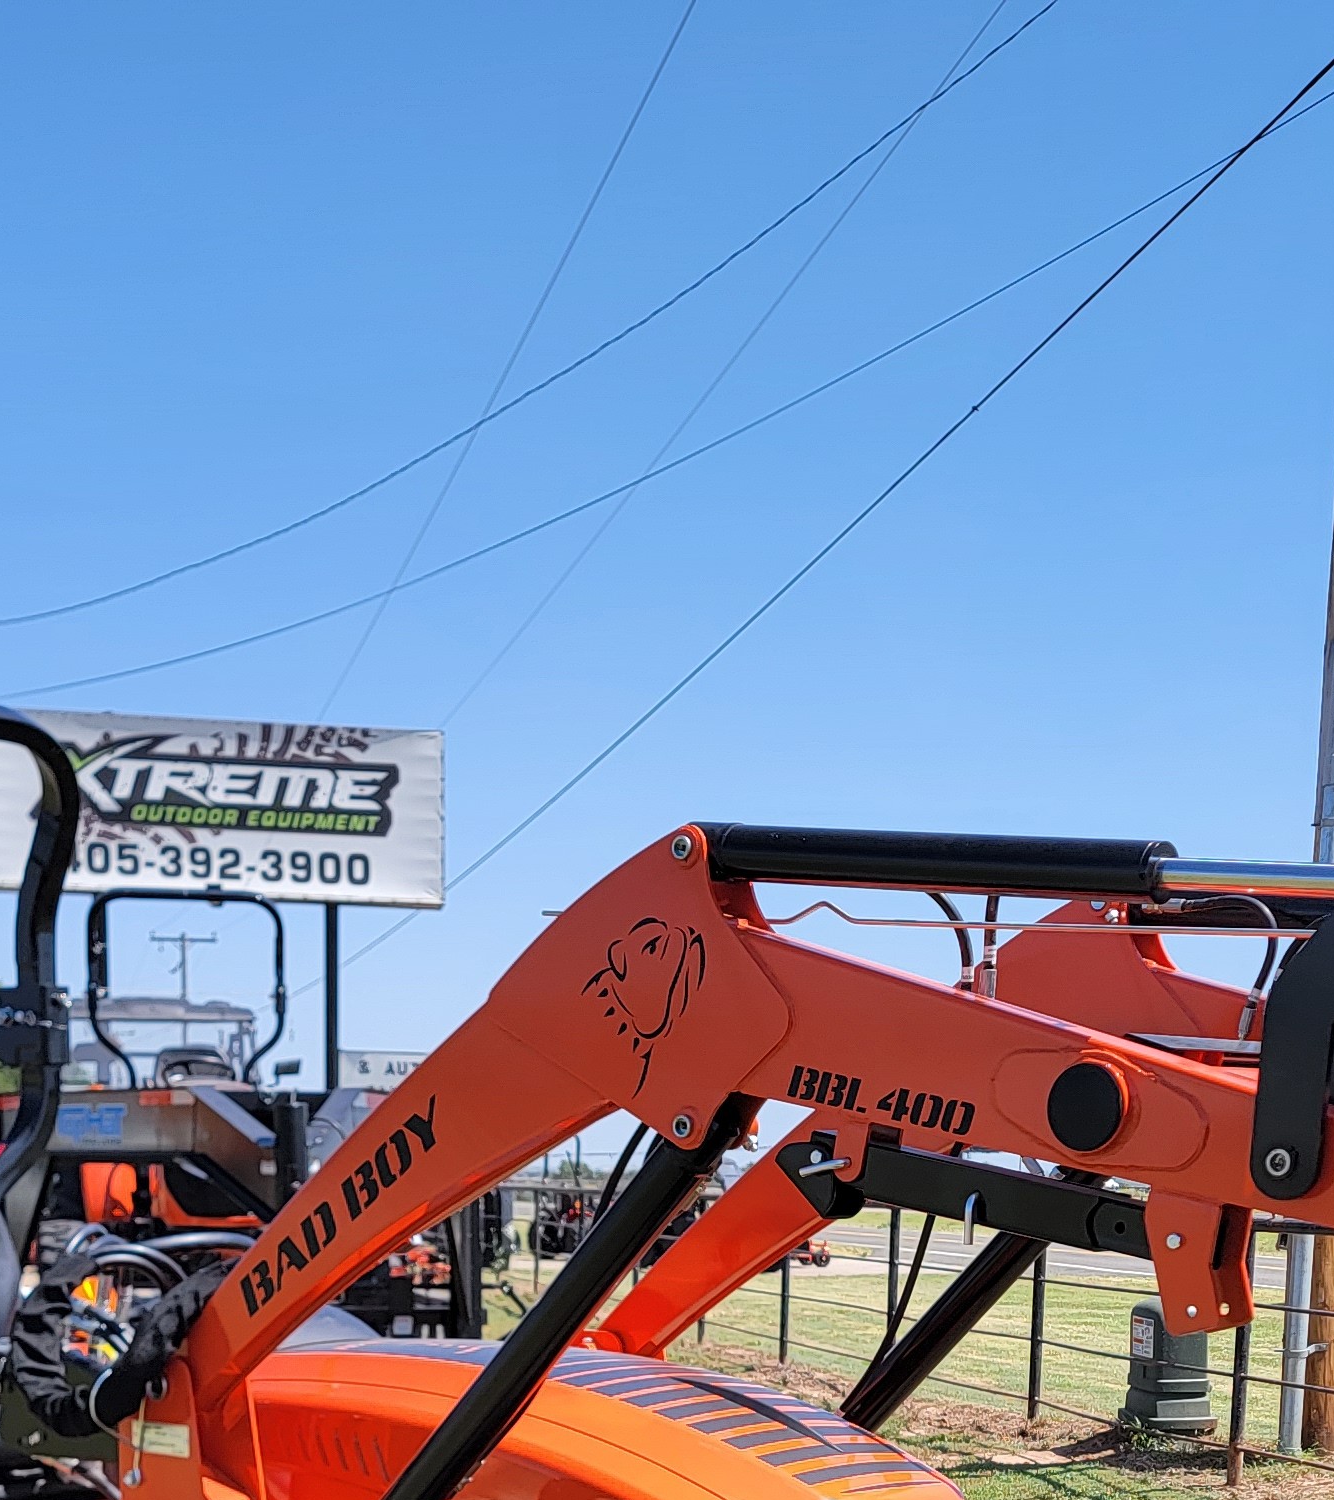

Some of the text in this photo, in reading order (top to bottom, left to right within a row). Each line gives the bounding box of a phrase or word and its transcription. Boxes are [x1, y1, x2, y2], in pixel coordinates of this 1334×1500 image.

[130, 804, 381, 833] OUTDOOR EQUIPMENT
[72, 842, 370, 885] 05-392-3900
[786, 1065, 976, 1136] BBL 400
[239, 1094, 437, 1318] BAD BOY
